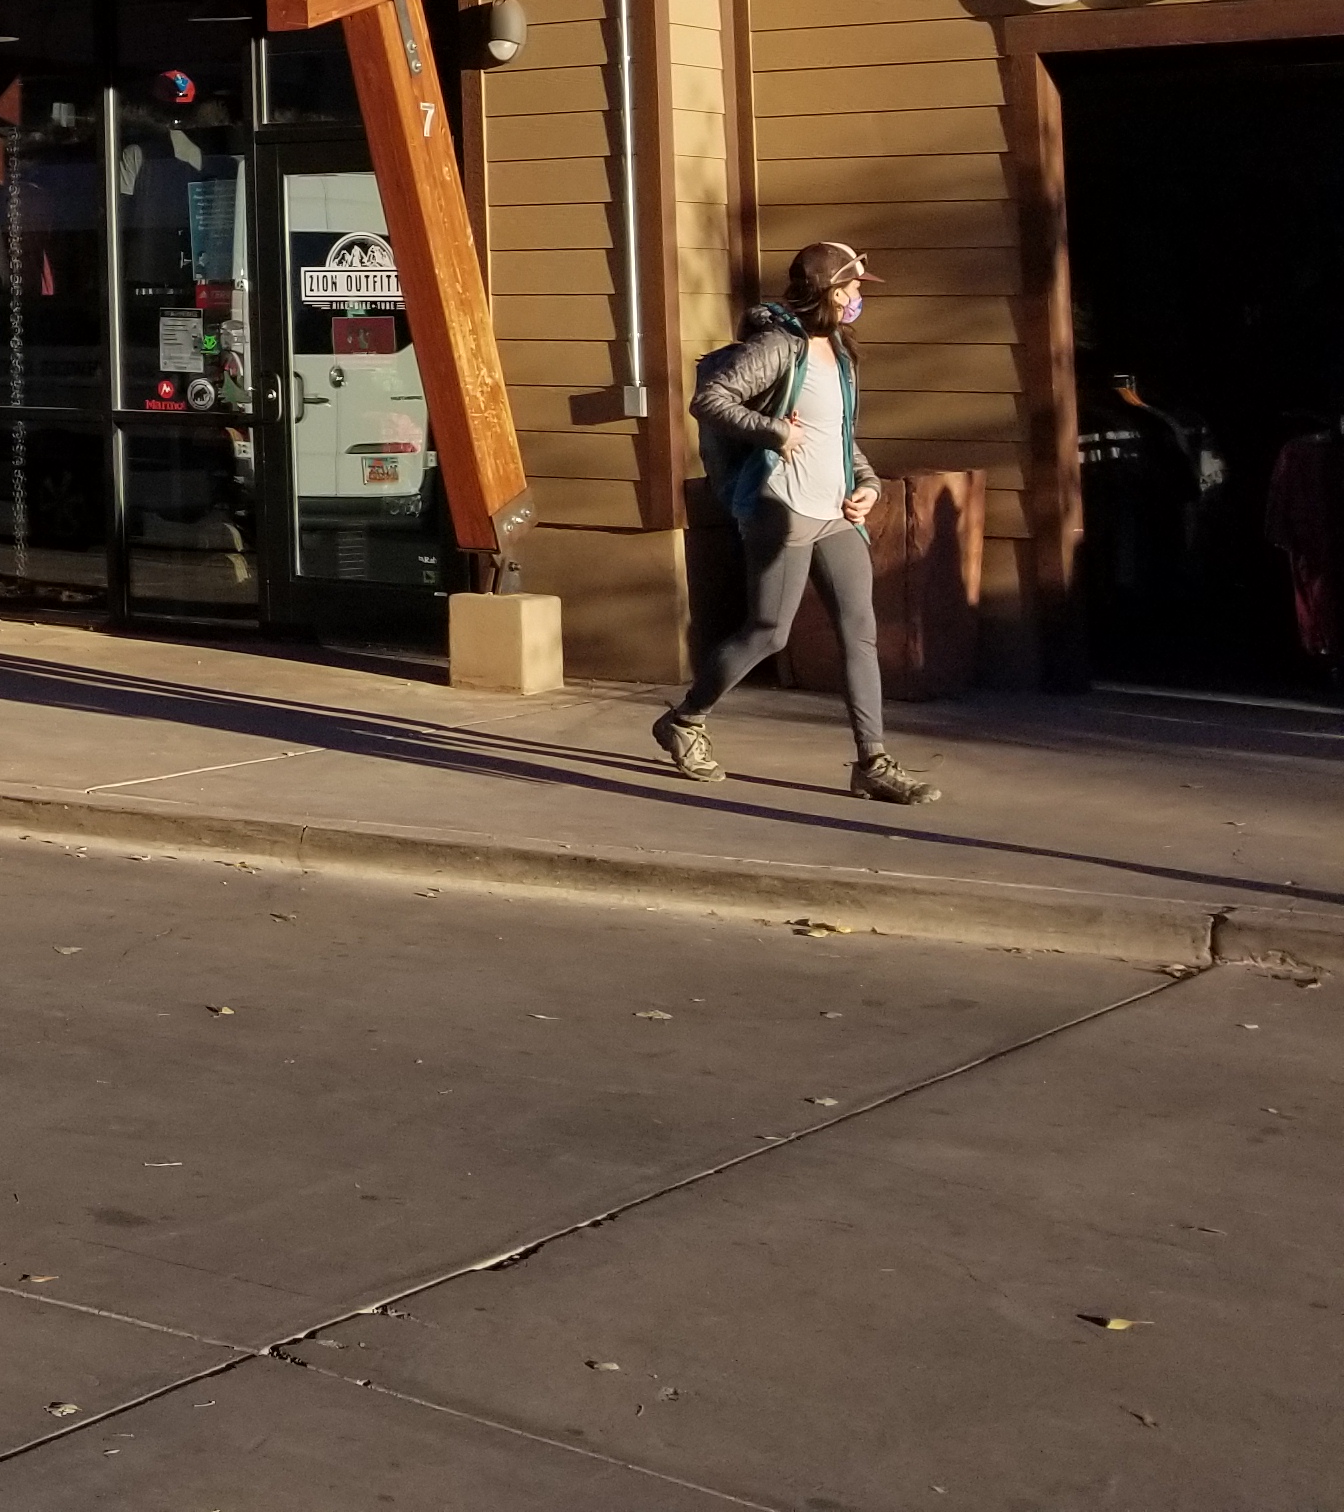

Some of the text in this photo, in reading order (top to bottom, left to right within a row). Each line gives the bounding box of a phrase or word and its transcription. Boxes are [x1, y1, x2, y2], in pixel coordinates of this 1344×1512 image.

[420, 102, 435, 137] 7
[309, 274, 400, 292] ZION OUTFITT
